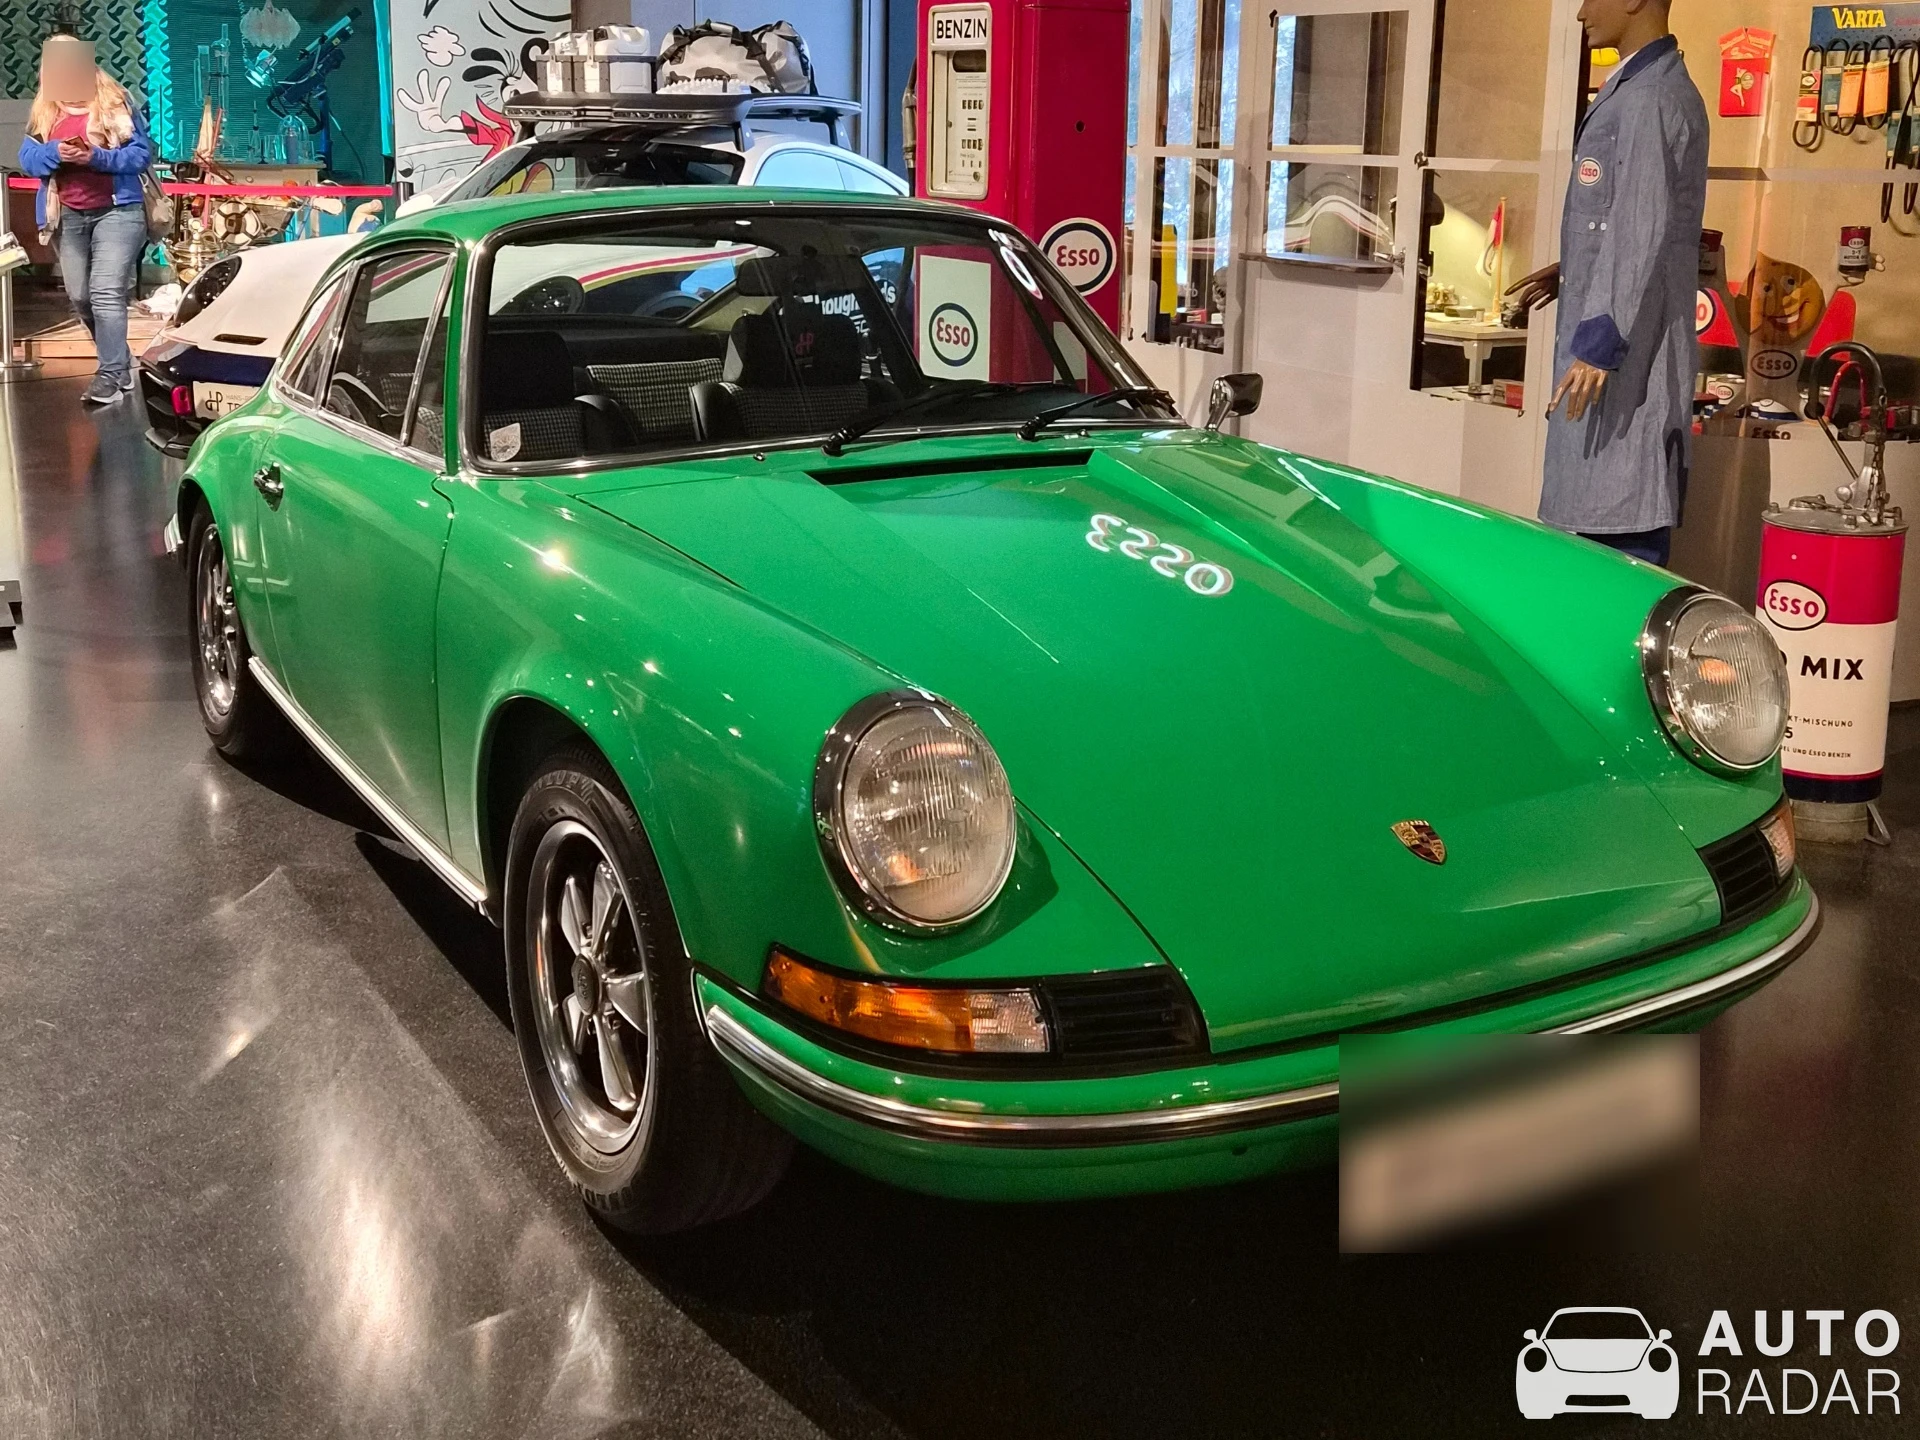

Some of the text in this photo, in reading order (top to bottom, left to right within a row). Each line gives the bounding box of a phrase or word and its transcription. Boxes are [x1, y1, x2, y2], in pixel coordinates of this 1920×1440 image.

[936, 18, 988, 39] BENZIN
[1832, 7, 1887, 30] VARTA
[1056, 245, 1100, 268] Esso
[936, 316, 971, 348] Esso
[1756, 356, 1792, 371] Esso
[1769, 588, 1820, 619] Esso
[1800, 655, 1864, 680] MIX
[1792, 747, 1807, 755] UND
